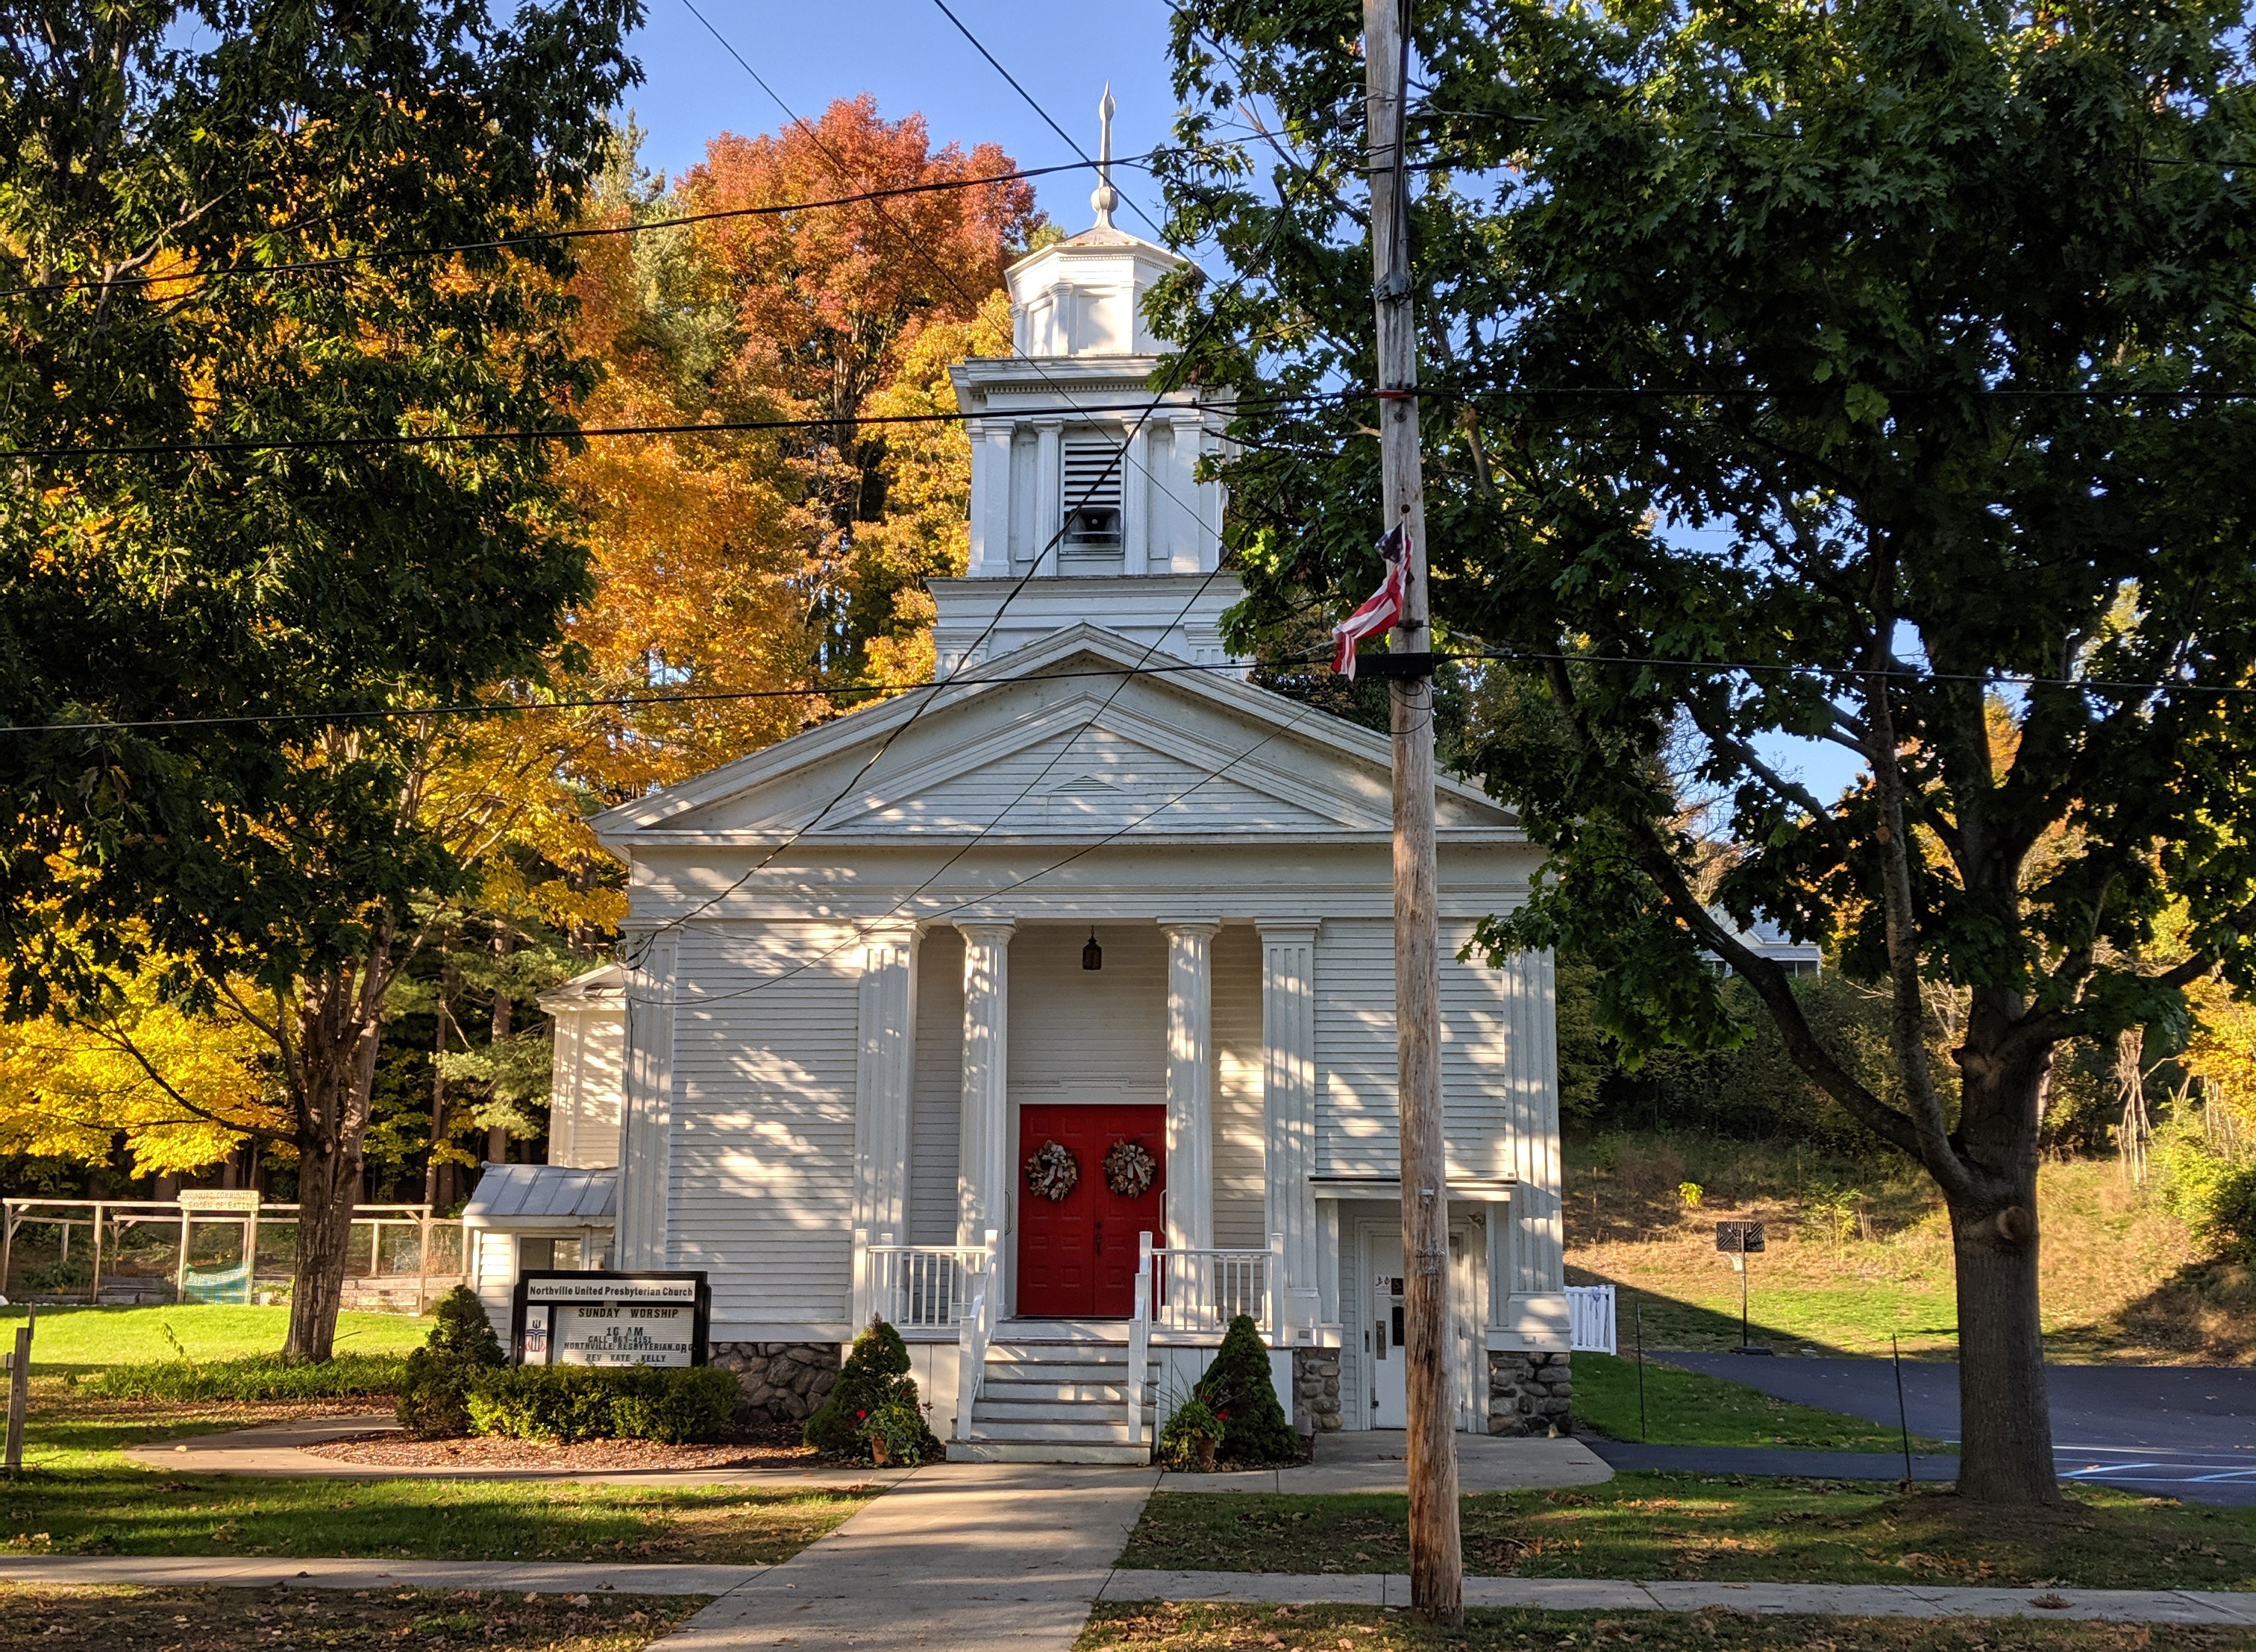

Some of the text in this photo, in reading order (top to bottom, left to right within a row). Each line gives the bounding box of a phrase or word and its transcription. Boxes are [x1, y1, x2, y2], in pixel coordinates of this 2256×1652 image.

[530, 1286, 692, 1297] Northville United Presbyterian Church
[578, 1308, 679, 1319] SUNDAY WORSHIP
[607, 1326, 643, 1336] 10 AM
